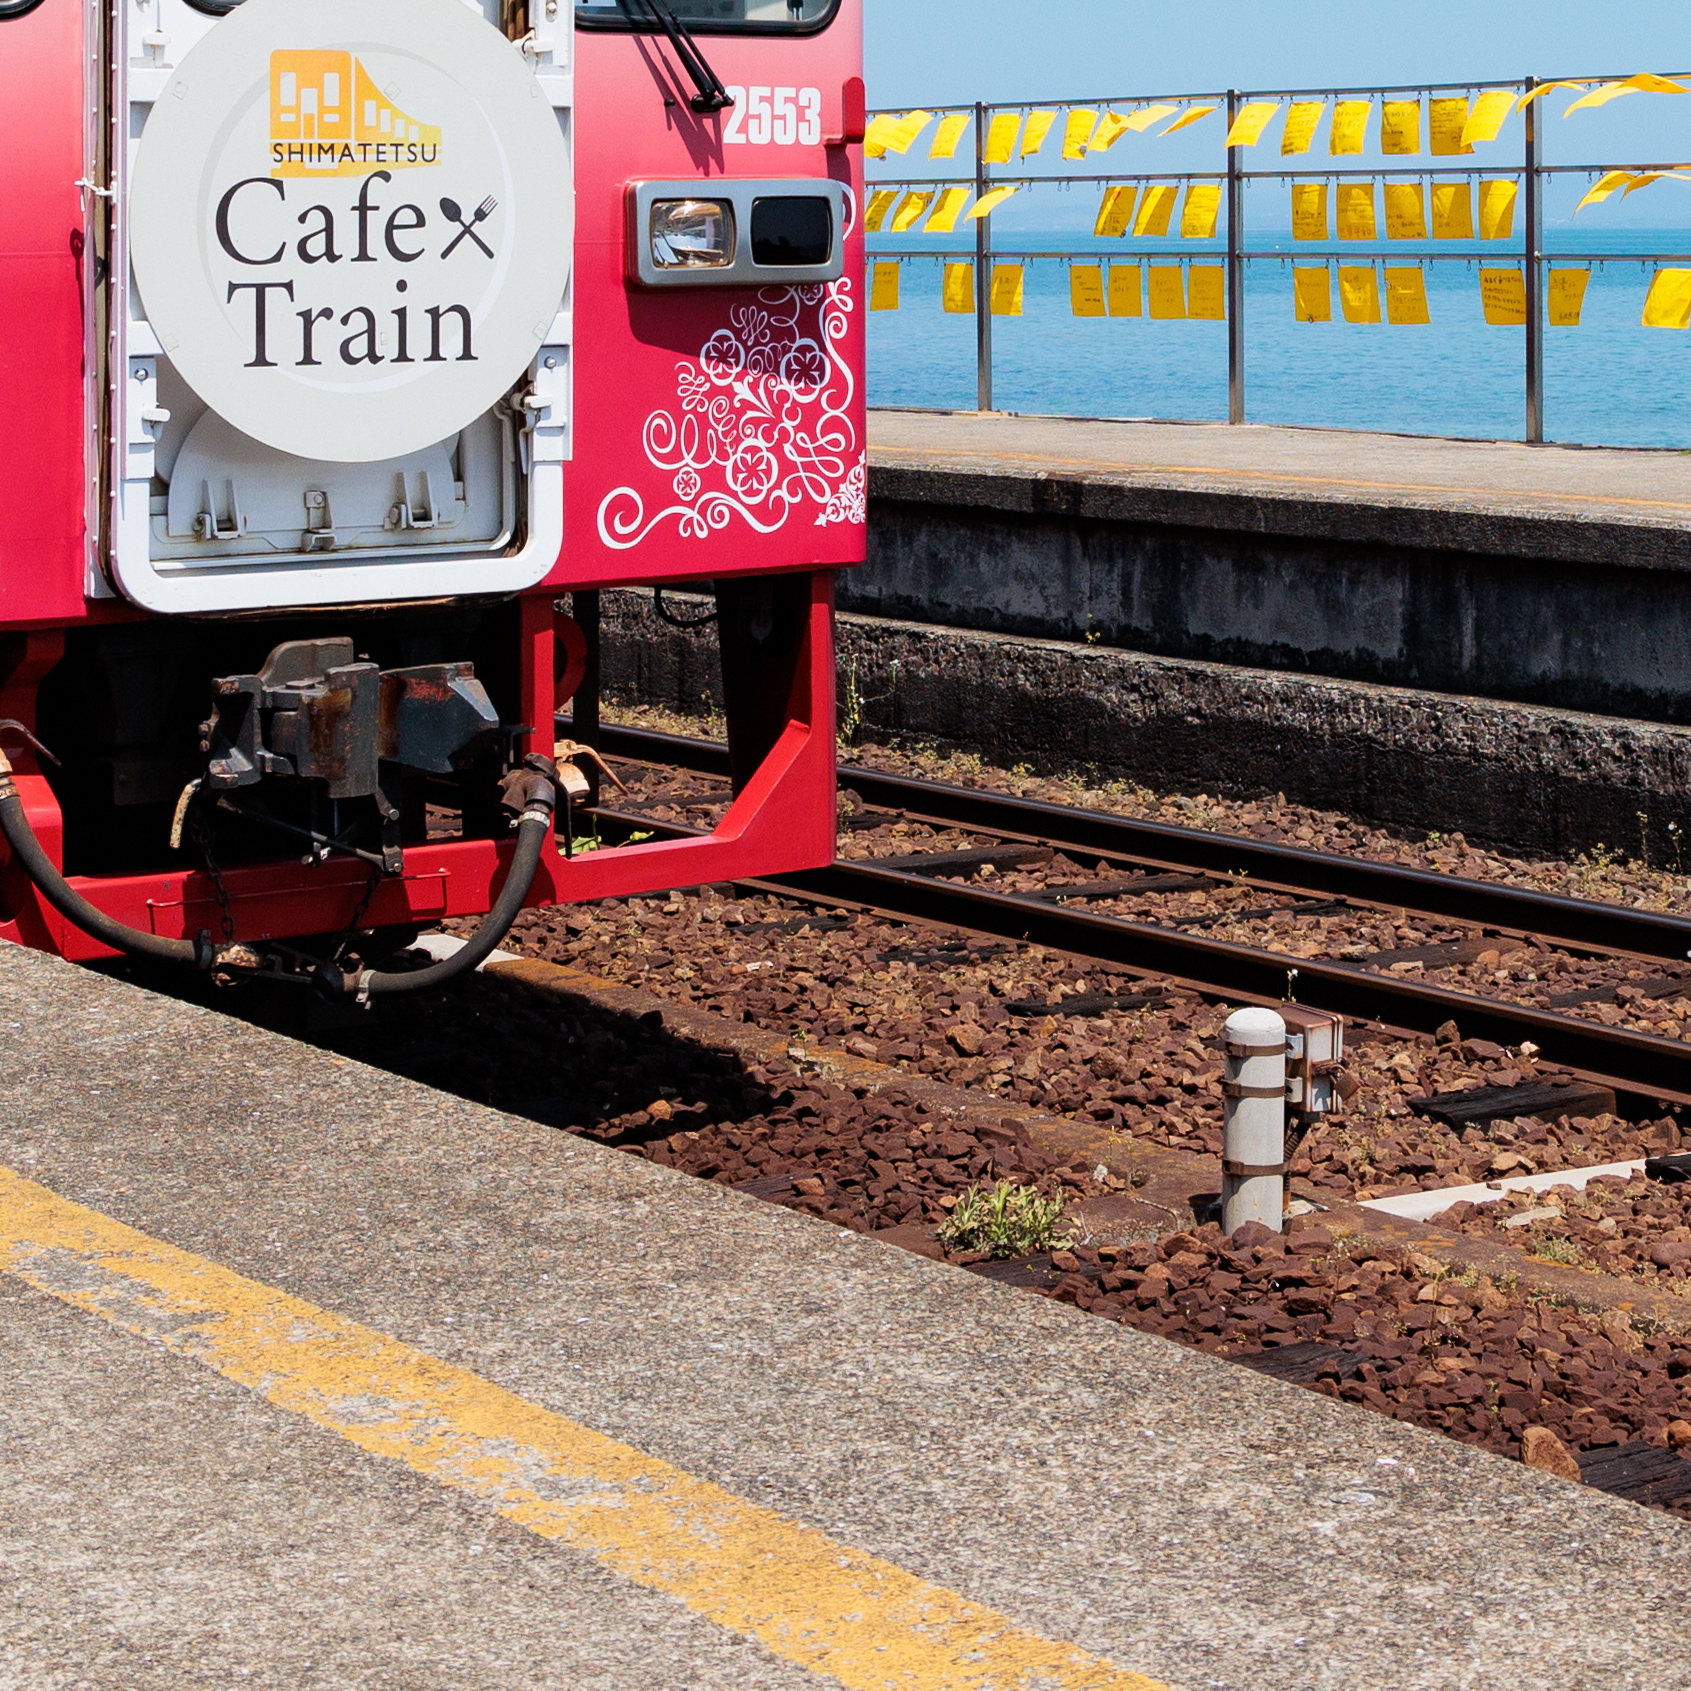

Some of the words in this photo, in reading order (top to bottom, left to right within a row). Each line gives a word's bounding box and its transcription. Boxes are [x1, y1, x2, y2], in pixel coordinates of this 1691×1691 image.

[723, 85, 821, 145] 2553
[273, 143, 438, 163] SHIMATETSU
[216, 170, 427, 265] Cafe
[227, 279, 479, 368] Train
